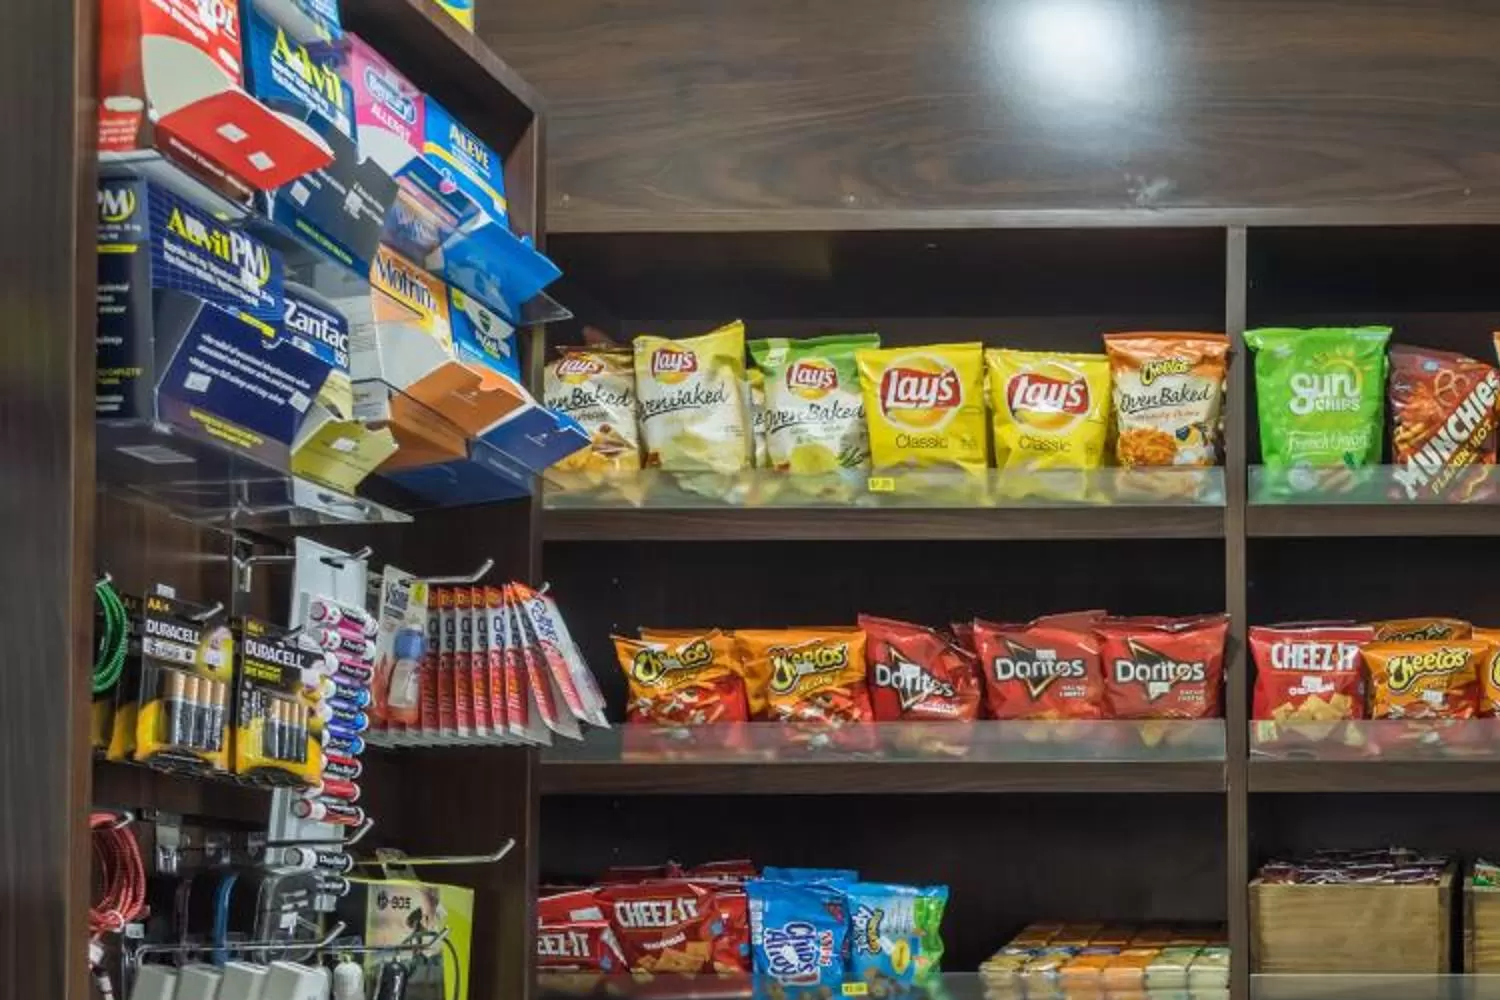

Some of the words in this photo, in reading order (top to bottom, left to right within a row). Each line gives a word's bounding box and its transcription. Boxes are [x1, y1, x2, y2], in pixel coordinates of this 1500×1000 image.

[449, 124, 490, 169] ALEVE
[283, 298, 349, 352] Zantac
[653, 350, 697, 372] Lay's
[788, 363, 837, 386] Lay's
[1138, 358, 1190, 386] Cheetos
[883, 367, 958, 409] Lay's
[1010, 370, 1086, 413] Lay's
[1159, 384, 1213, 406] Baked
[895, 433, 949, 450] Classic
[146, 618, 200, 646] DURACELL
[245, 639, 303, 669] DURACELL
[995, 657, 1085, 681] Doritos
[1115, 660, 1205, 683] Doritos
[1387, 647, 1468, 690] Cheetos
[784, 922, 815, 974] Chips
